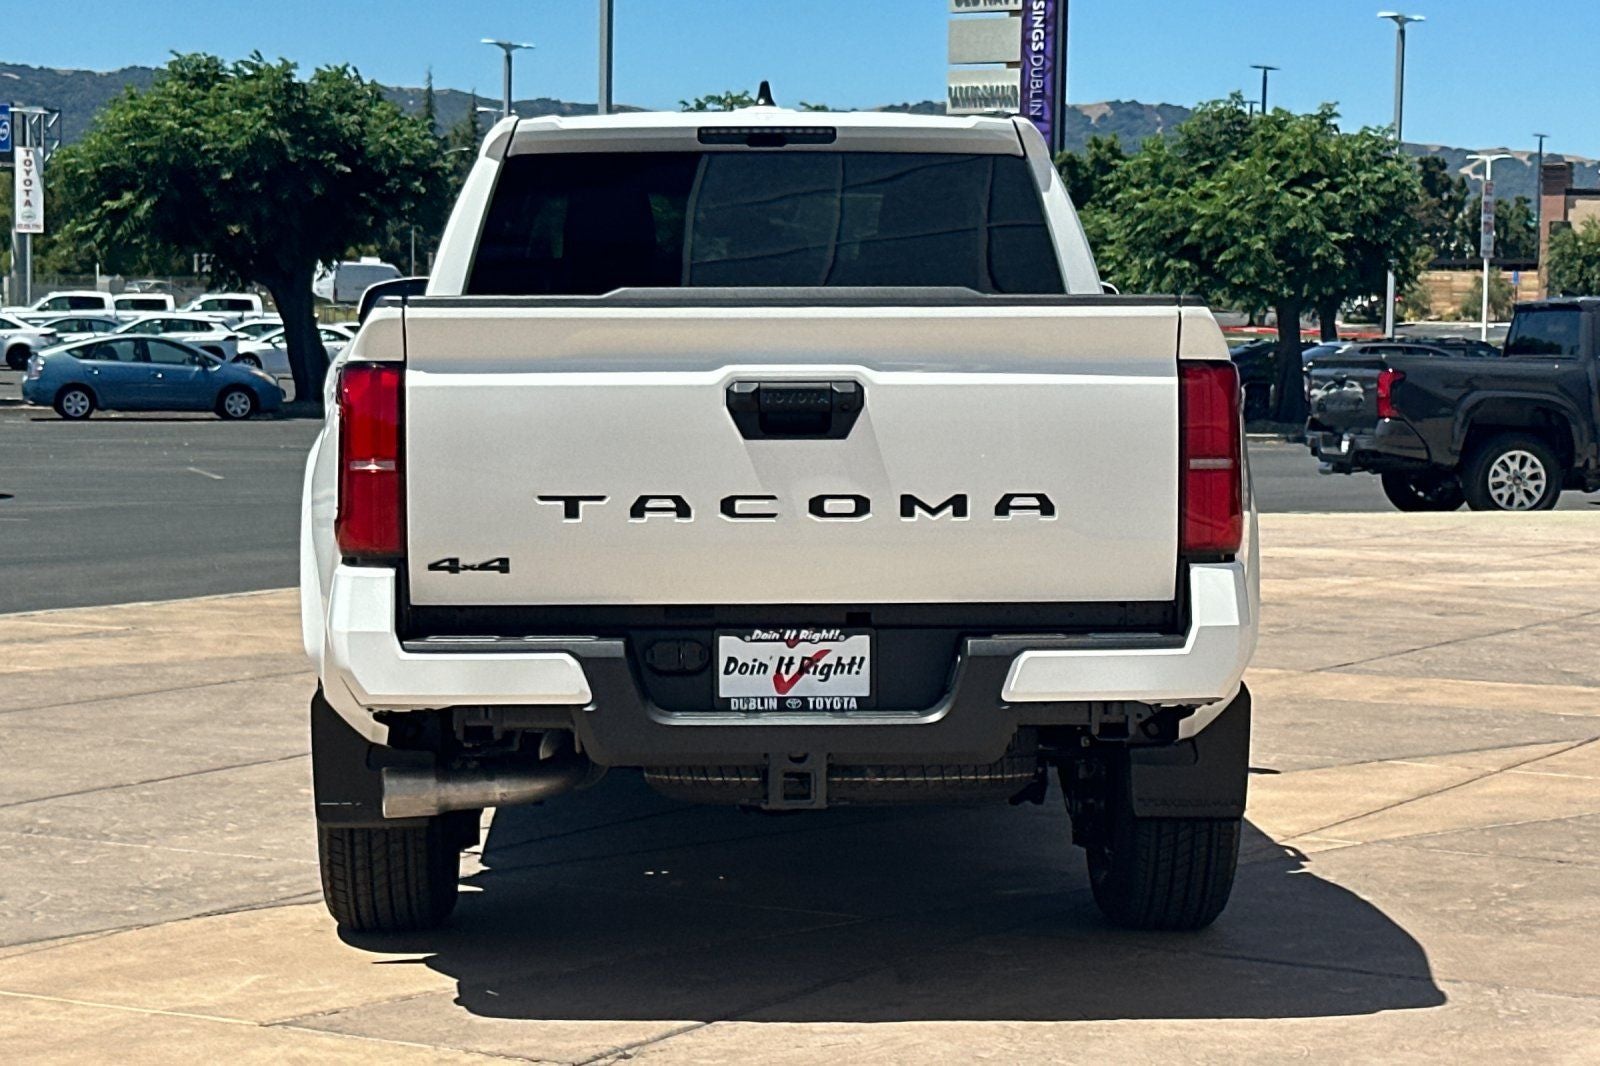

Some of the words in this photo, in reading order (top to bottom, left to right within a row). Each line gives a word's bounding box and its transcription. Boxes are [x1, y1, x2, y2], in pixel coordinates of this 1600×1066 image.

[1030, 55, 1044, 116] DUBLIN
[22, 149, 34, 208] TOYOTA
[537, 493, 1056, 519] TACOMA
[428, 557, 510, 574] 4x4
[751, 629, 783, 641] Doin'
[784, 629, 796, 640] It
[798, 629, 841, 643] Right!
[723, 656, 773, 676] Doin'
[775, 656, 795, 676] It
[800, 656, 866, 682] Right!
[730, 697, 778, 711] DUBLIN
[807, 697, 858, 710] TOYOTA
